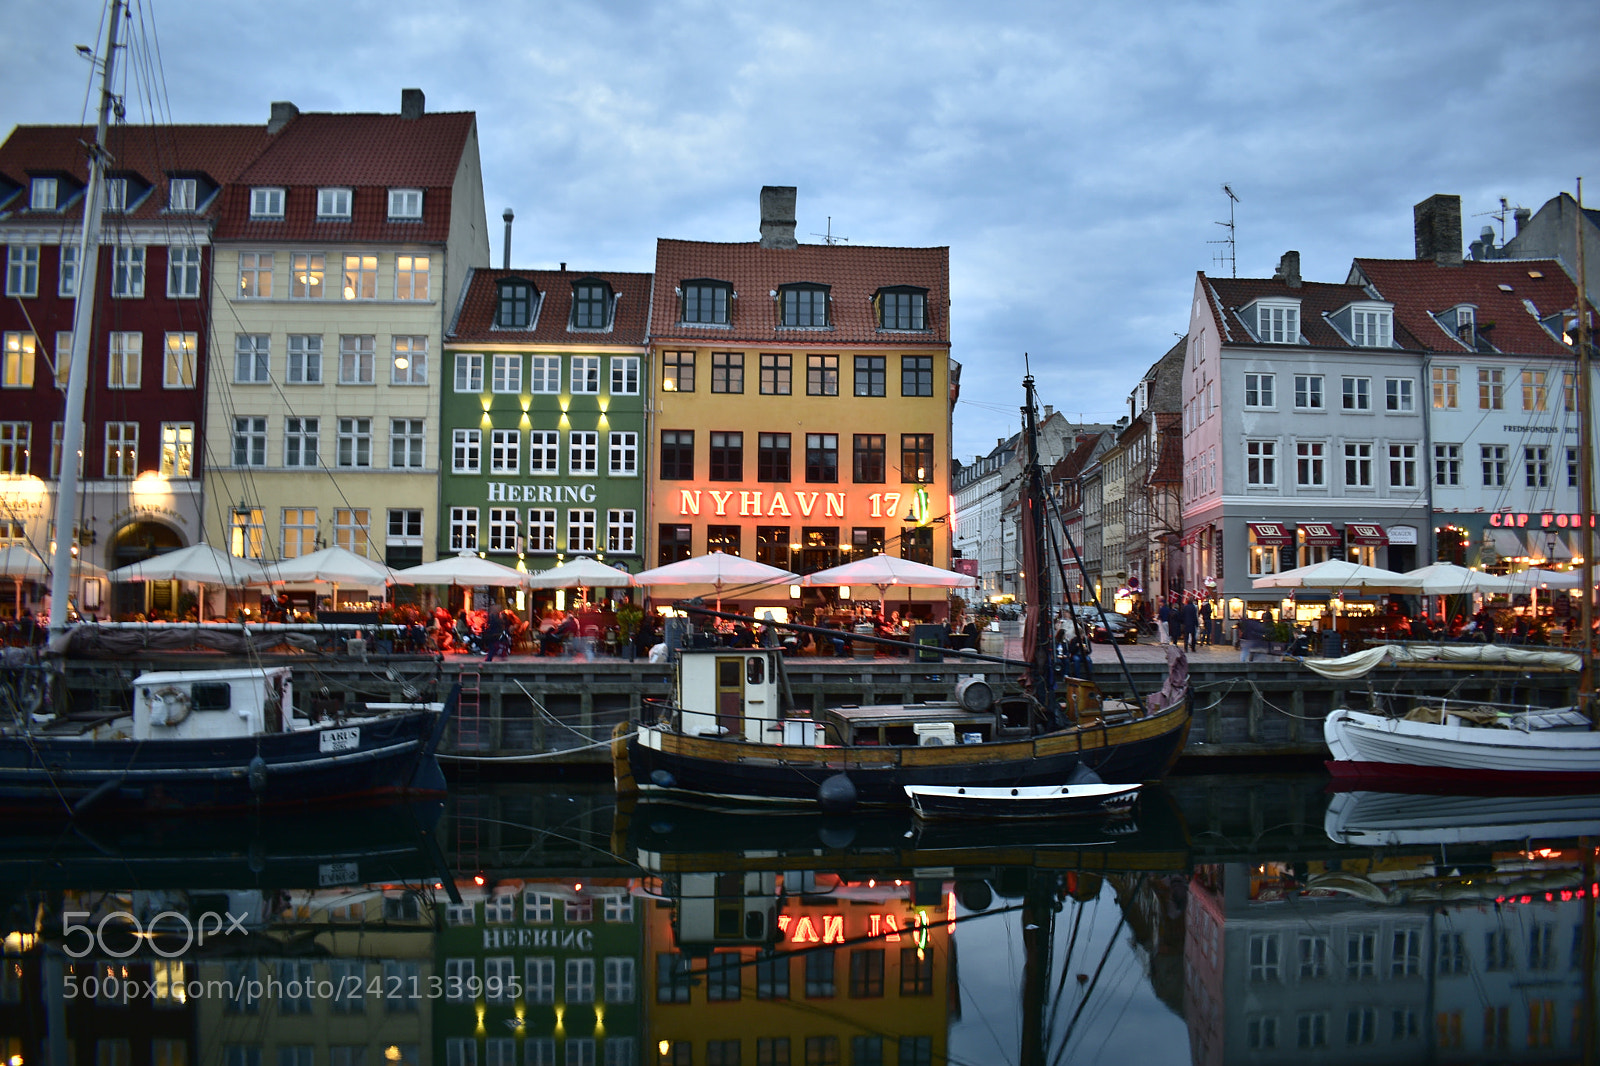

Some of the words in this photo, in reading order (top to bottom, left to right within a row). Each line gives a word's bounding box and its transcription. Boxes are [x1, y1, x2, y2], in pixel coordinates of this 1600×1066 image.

[487, 482, 597, 503] HEERING
[680, 489, 845, 517] NYHAVN
[869, 493, 901, 517] 17
[1490, 513, 1529, 528] CAP
[322, 731, 357, 742] LARUS
